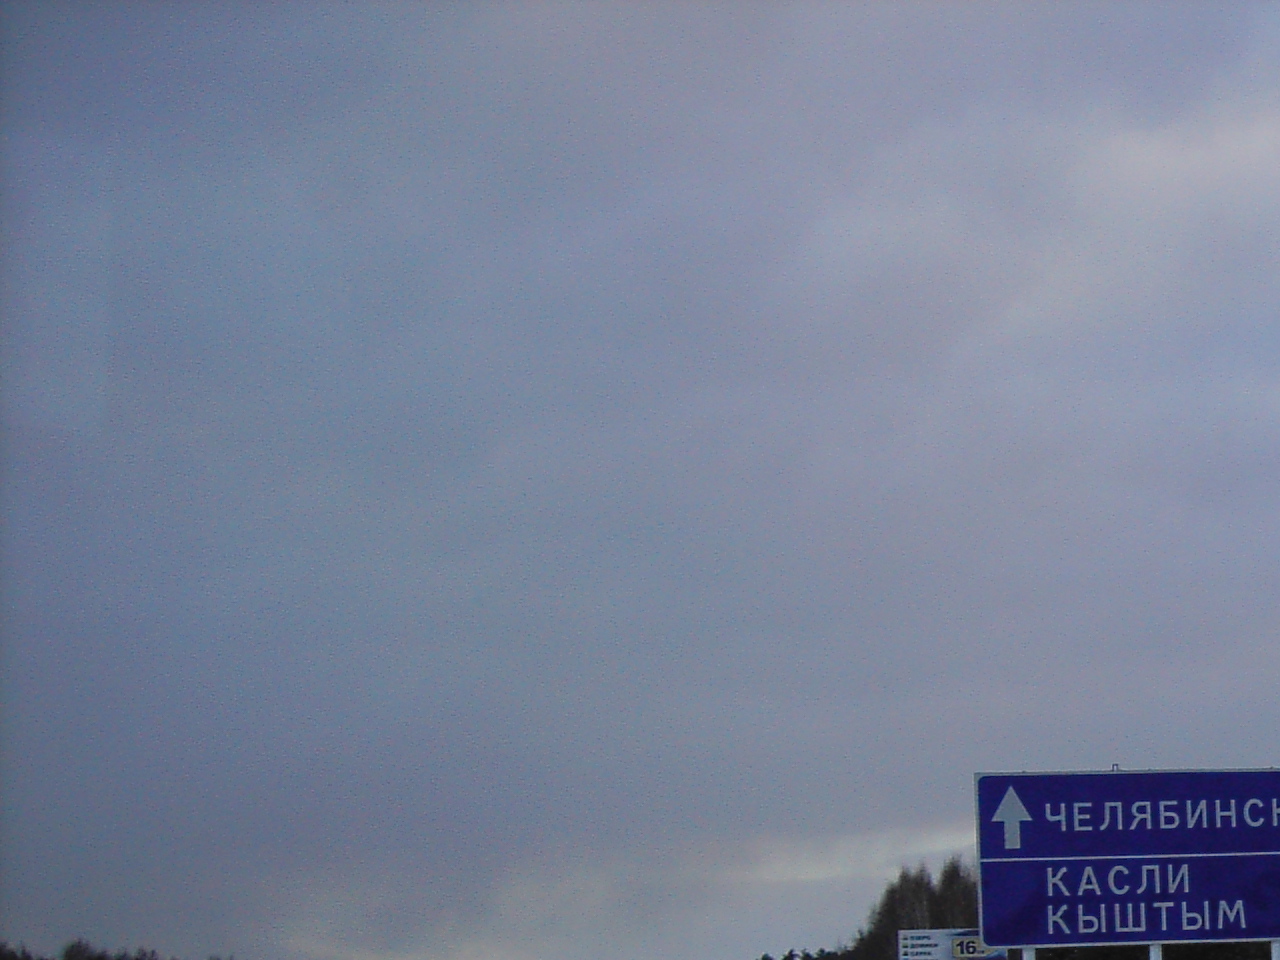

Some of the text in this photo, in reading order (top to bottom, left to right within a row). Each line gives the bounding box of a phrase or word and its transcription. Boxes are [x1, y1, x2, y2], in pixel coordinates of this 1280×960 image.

[1046, 864, 1190, 897] КАСЛИ
[1047, 899, 1247, 935] КЫШТЫМ
[956, 940, 977, 954] 16
